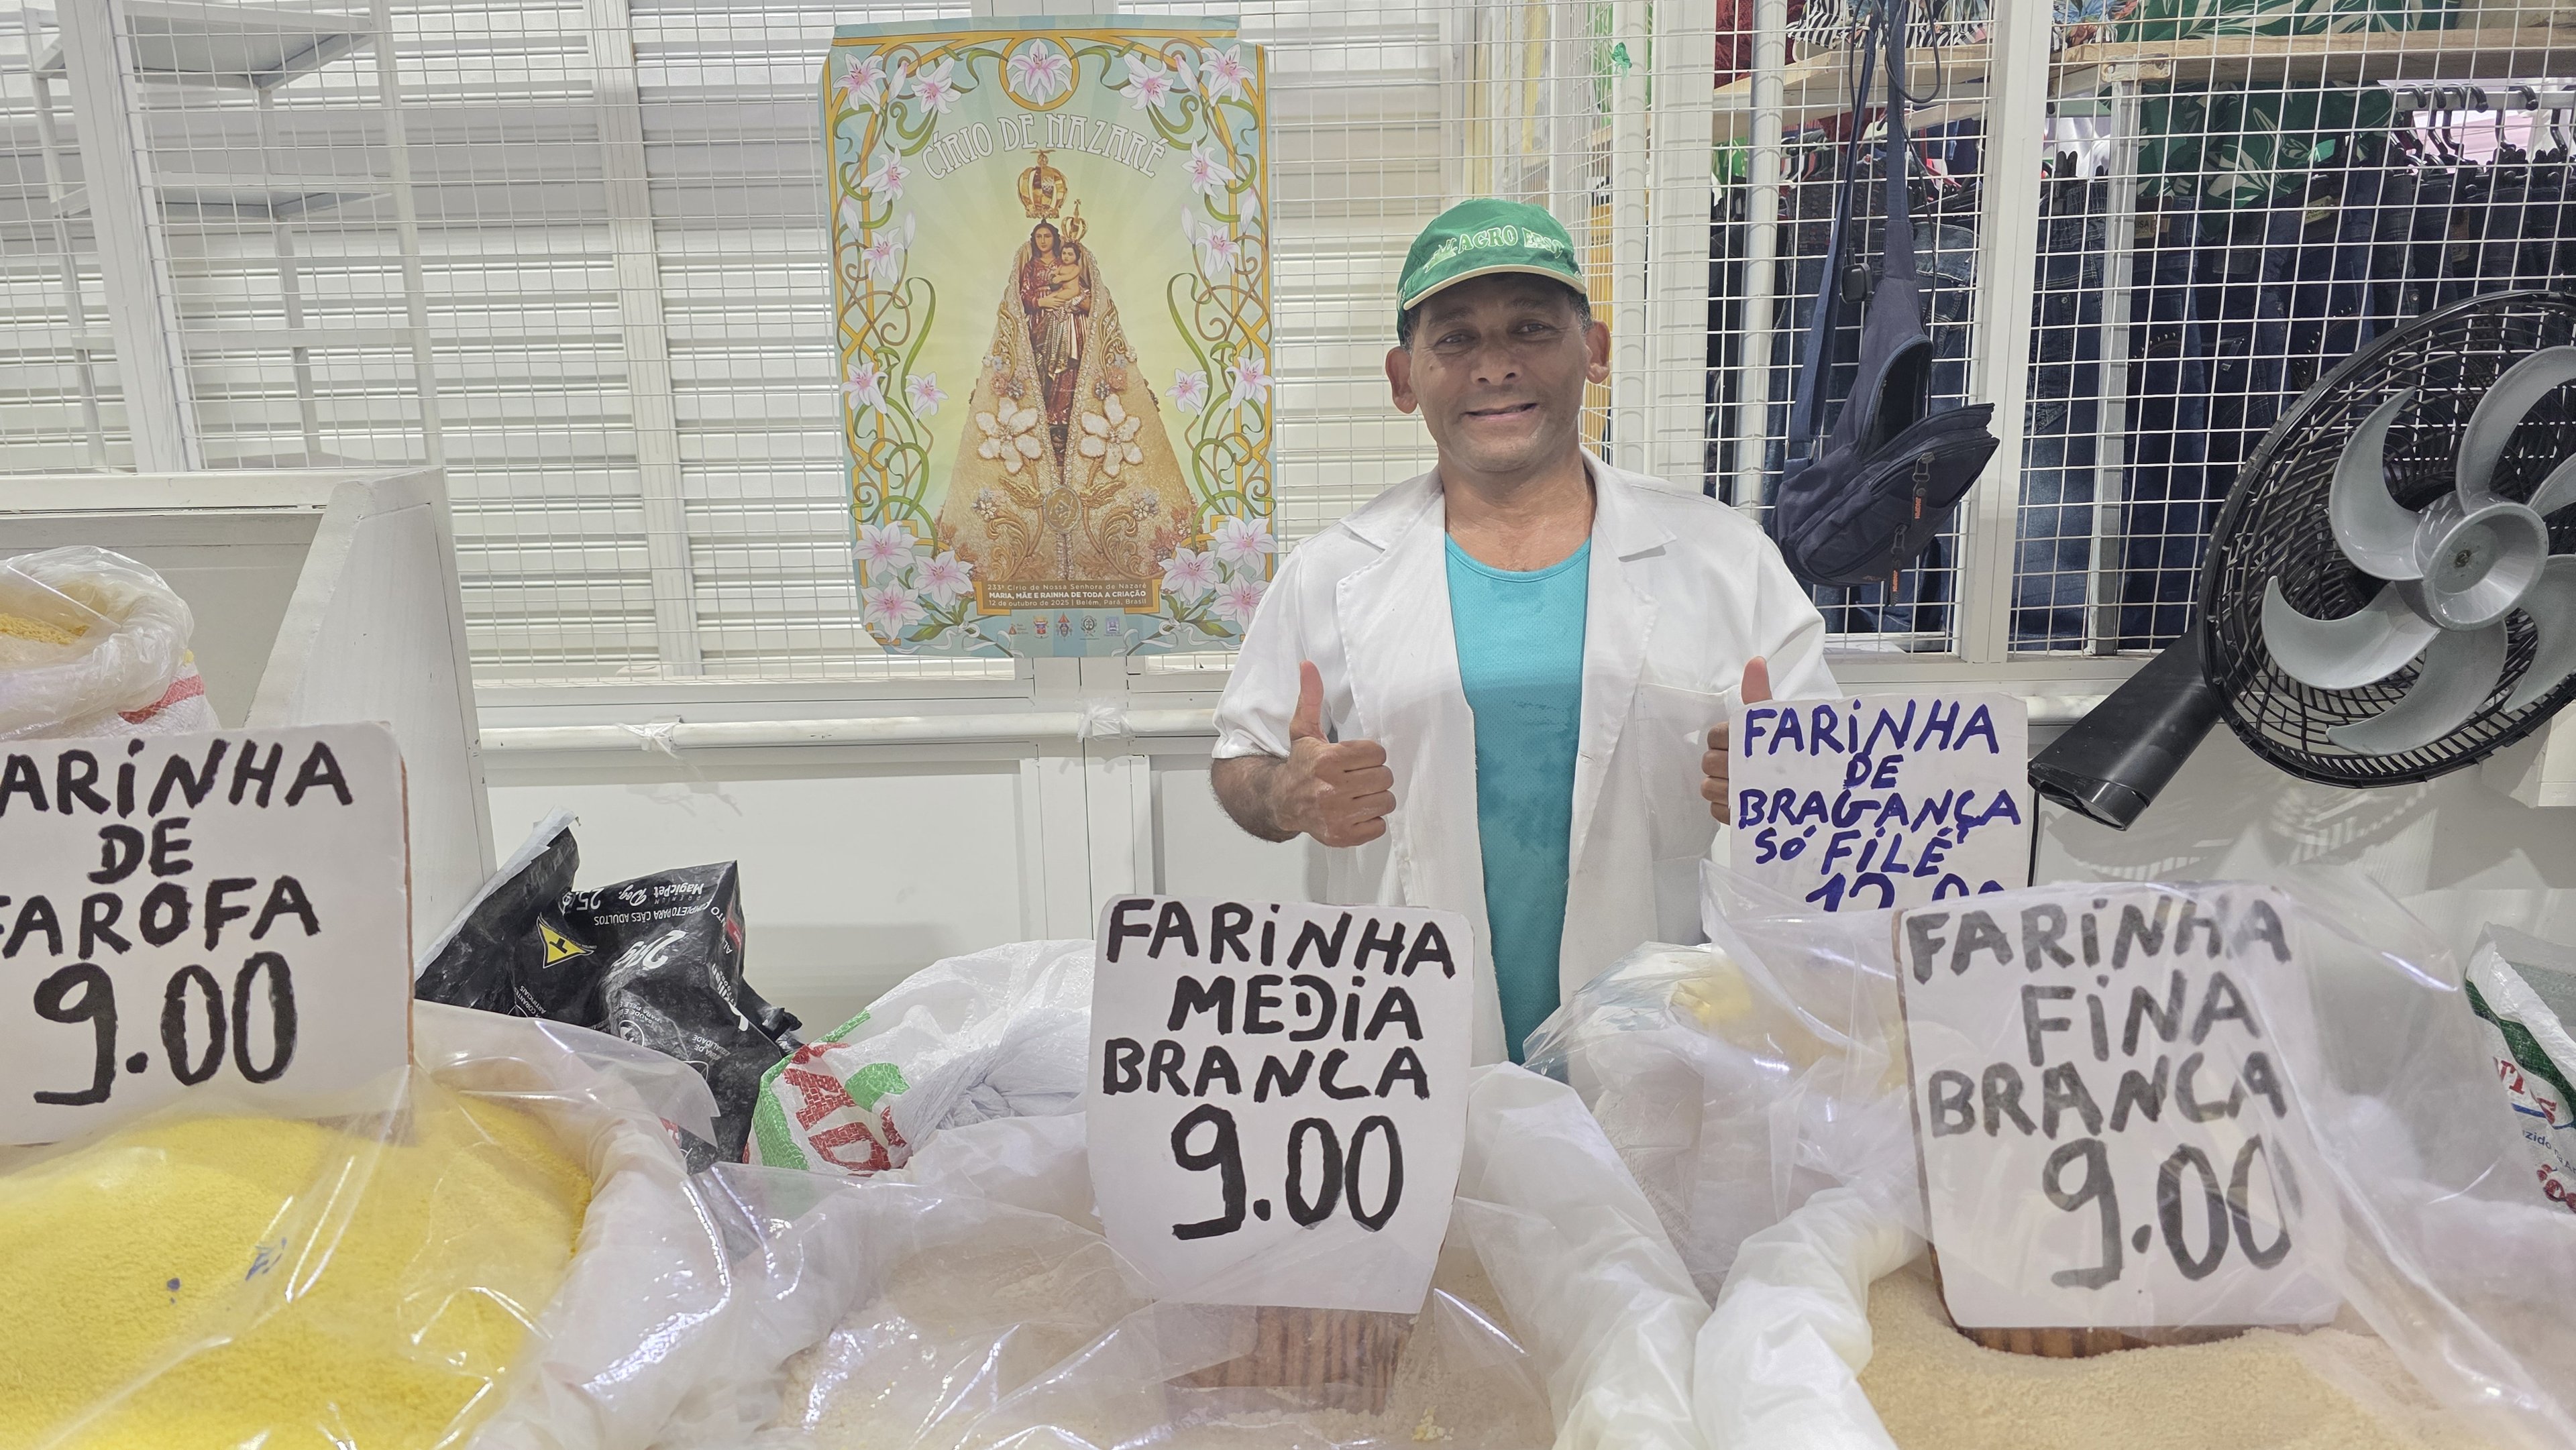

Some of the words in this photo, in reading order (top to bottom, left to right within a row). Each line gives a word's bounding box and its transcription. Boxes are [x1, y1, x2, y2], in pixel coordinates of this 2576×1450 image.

[922, 122, 994, 180] CÍRIO
[998, 113, 1038, 152] DE
[1045, 113, 1169, 178] NAZARÉ
[1458, 225, 1518, 254] AGRO
[989, 592, 1014, 600] MARIA,
[1016, 591, 1032, 599] MÃE
[1112, 590, 1146, 598] CRIAÇÃO
[1843, 752, 1904, 789] DE
[1739, 788, 2021, 844] BRAGANÇA
[87, 817, 193, 885] DE
[594, 913, 629, 926] ADULTOS
[632, 911, 651, 924] CÃES
[654, 909, 672, 920] PARA
[34, 952, 298, 1105] 9.00
[1103, 1038, 1430, 1103] BRANCA
[1928, 1052, 2287, 1139] BRANCA
[2522, 1129, 2552, 1150] zido
[1171, 1103, 1405, 1241] 9.00
[2043, 1133, 2302, 1290] 9.00
